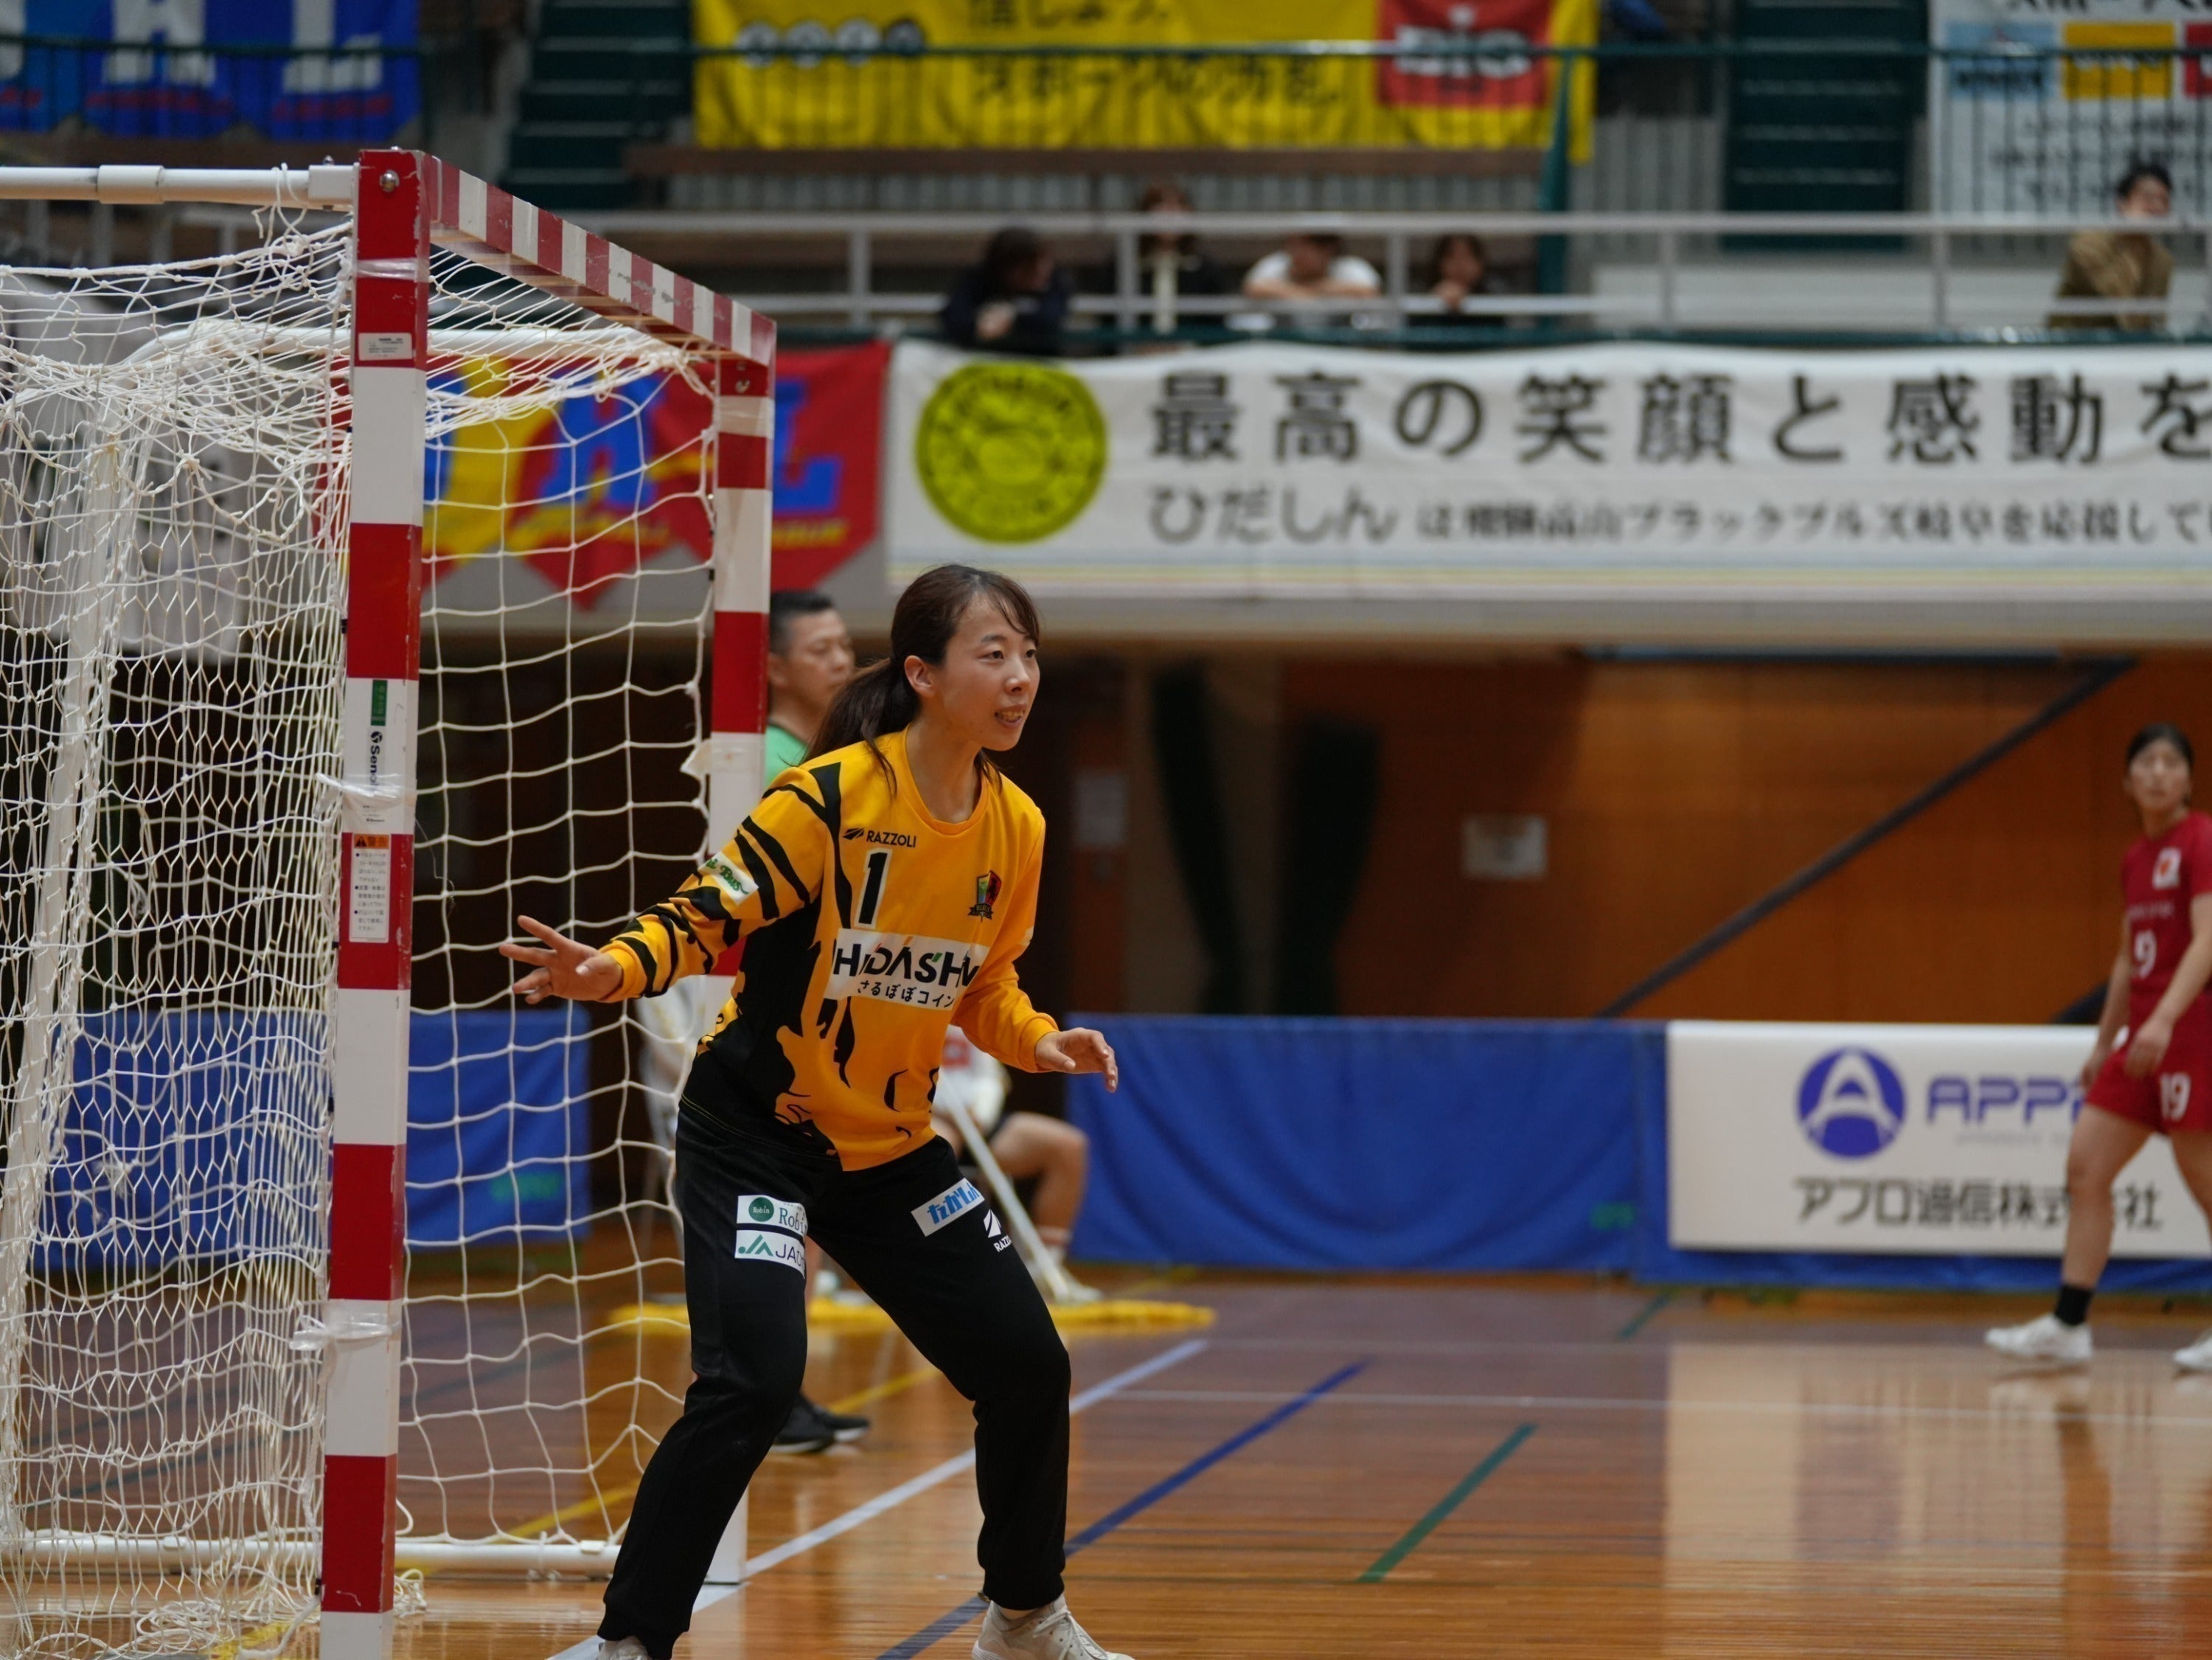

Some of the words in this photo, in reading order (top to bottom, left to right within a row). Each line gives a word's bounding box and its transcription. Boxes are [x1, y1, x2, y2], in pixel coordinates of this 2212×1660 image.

[1149, 369, 2212, 468] 最高の笑顔と感動を
[1147, 484, 1398, 544] ひだしん
[866, 830, 917, 848] RAZZOLI
[856, 850, 891, 927] 1
[858, 979, 955, 1008] さるぼぼコイン
[752, 1205, 771, 1214] Robin
